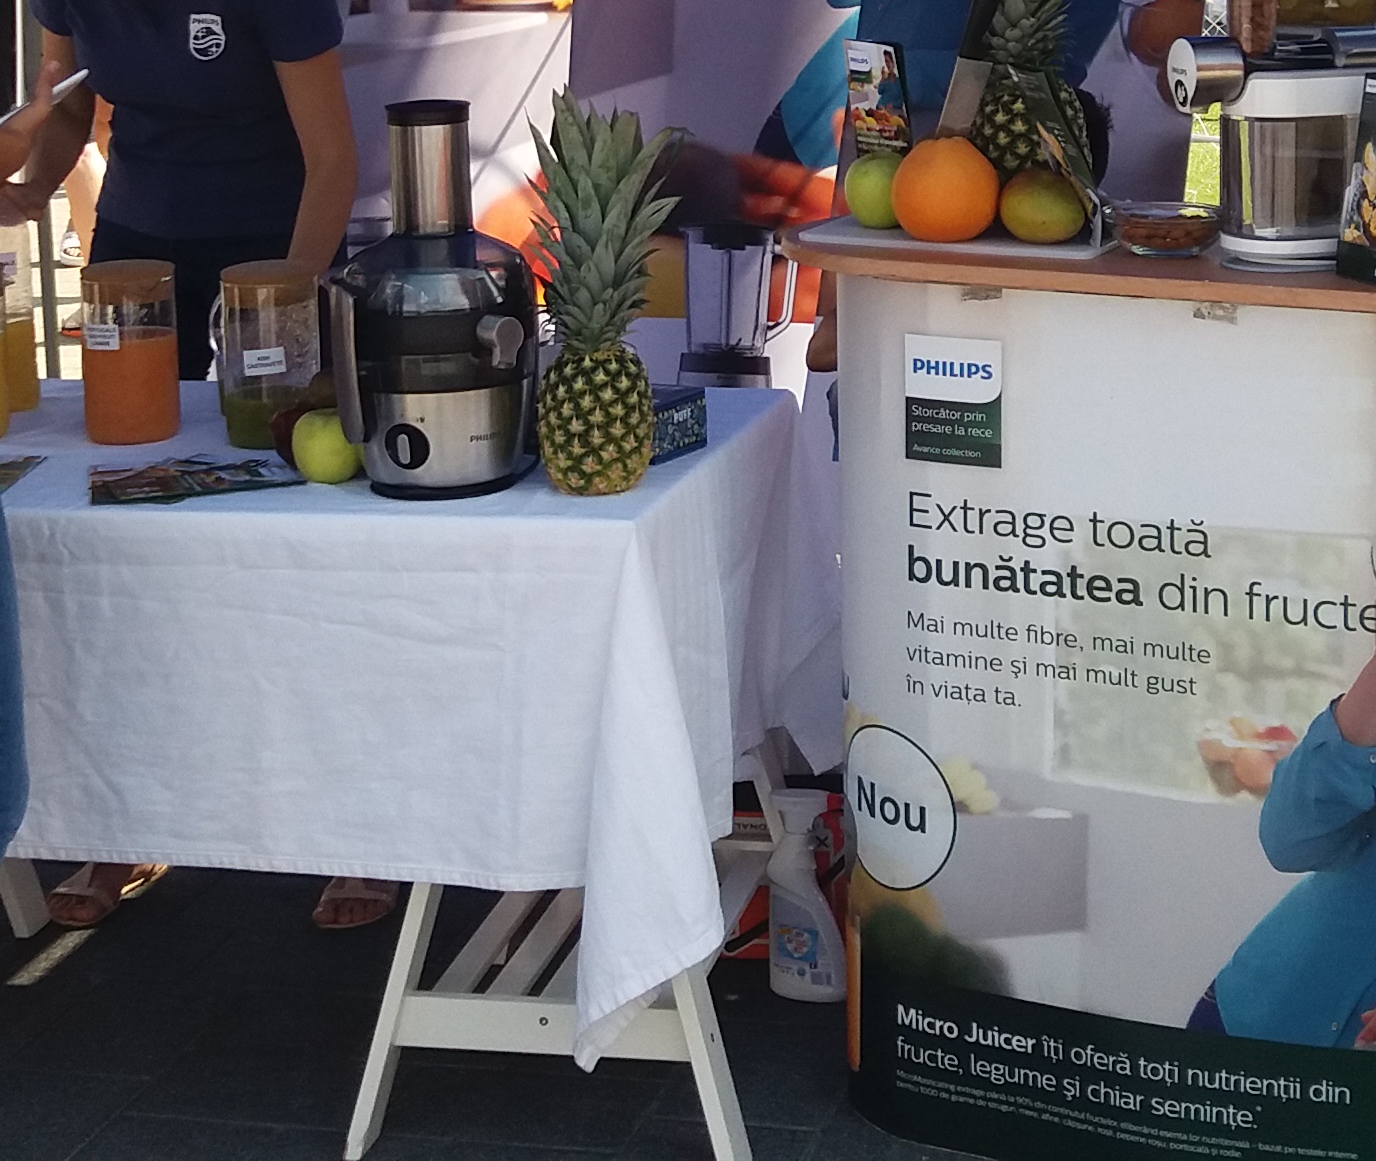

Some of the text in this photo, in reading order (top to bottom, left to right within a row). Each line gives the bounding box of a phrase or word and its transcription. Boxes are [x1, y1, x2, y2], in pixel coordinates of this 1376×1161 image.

[912, 357, 994, 380] PHILIPS
[911, 404, 987, 423] Storcător prin
[911, 421, 994, 439] presare la rece
[908, 490, 1212, 560] Extrage toată
[907, 543, 1145, 608] bunătatea
[1157, 572, 1230, 619] din
[906, 609, 1212, 665] Mai multe fibre, mai multe
[905, 673, 925, 696] în
[993, 685, 1023, 708] ta.
[906, 644, 1004, 673] vitamine
[1035, 661, 1077, 682] mai
[1085, 666, 1139, 690] mult
[1145, 674, 1198, 696] gust
[856, 775, 928, 836] Nou
[896, 1002, 959, 1040] Micro
[963, 1021, 1037, 1055] Juicer
[1070, 1044, 1132, 1077] oferă
[1309, 1079, 1352, 1106] din
[896, 1035, 964, 1077] fructe,
[970, 1052, 1058, 1093] legume
[1087, 1080, 1145, 1112] chiar
